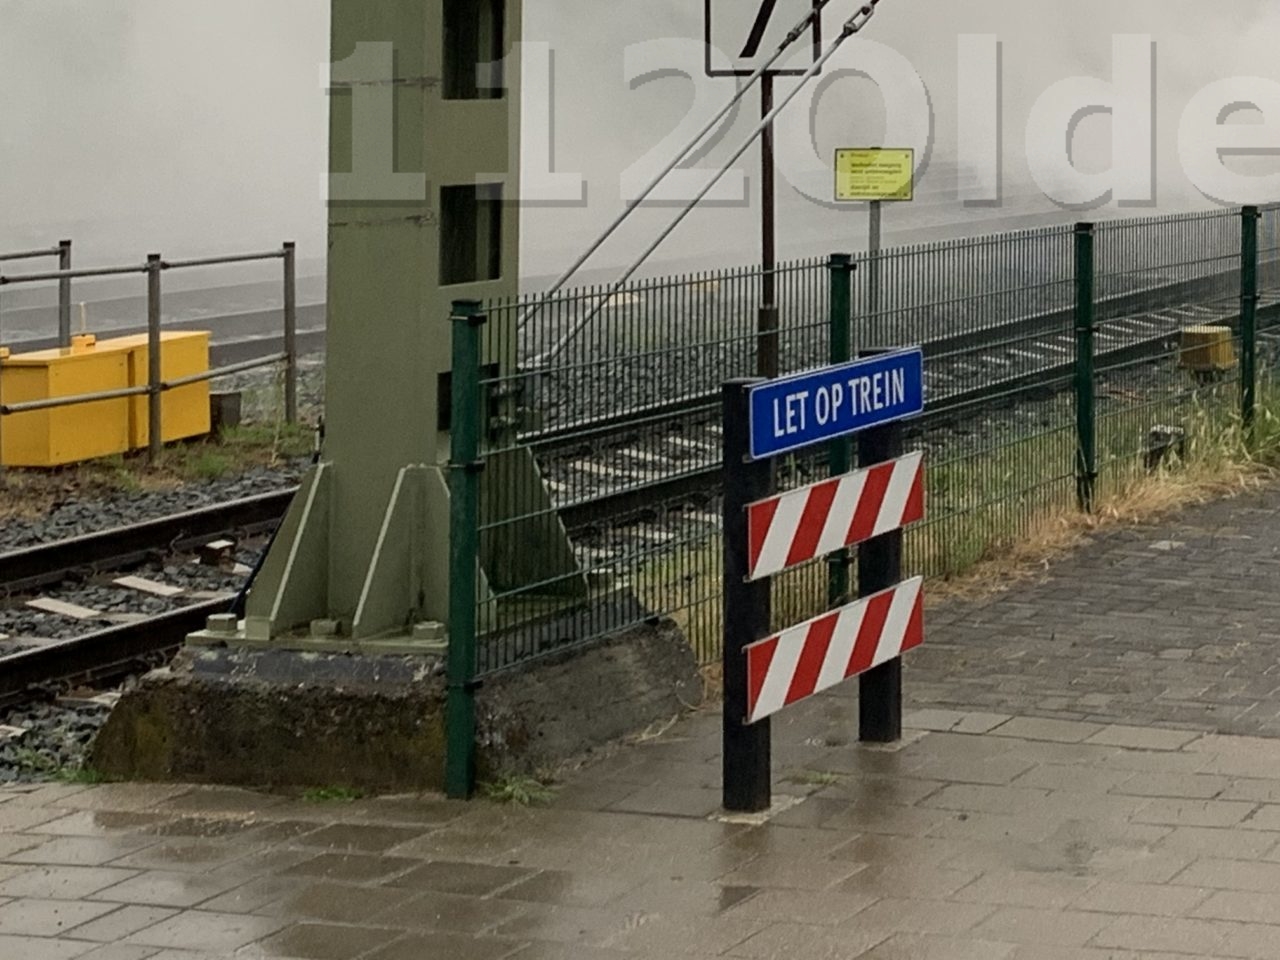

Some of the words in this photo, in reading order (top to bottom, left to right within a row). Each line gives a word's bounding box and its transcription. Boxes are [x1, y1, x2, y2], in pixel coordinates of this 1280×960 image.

[773, 390, 809, 439] LET
[815, 382, 844, 426] OP
[848, 367, 905, 416] TREIN
